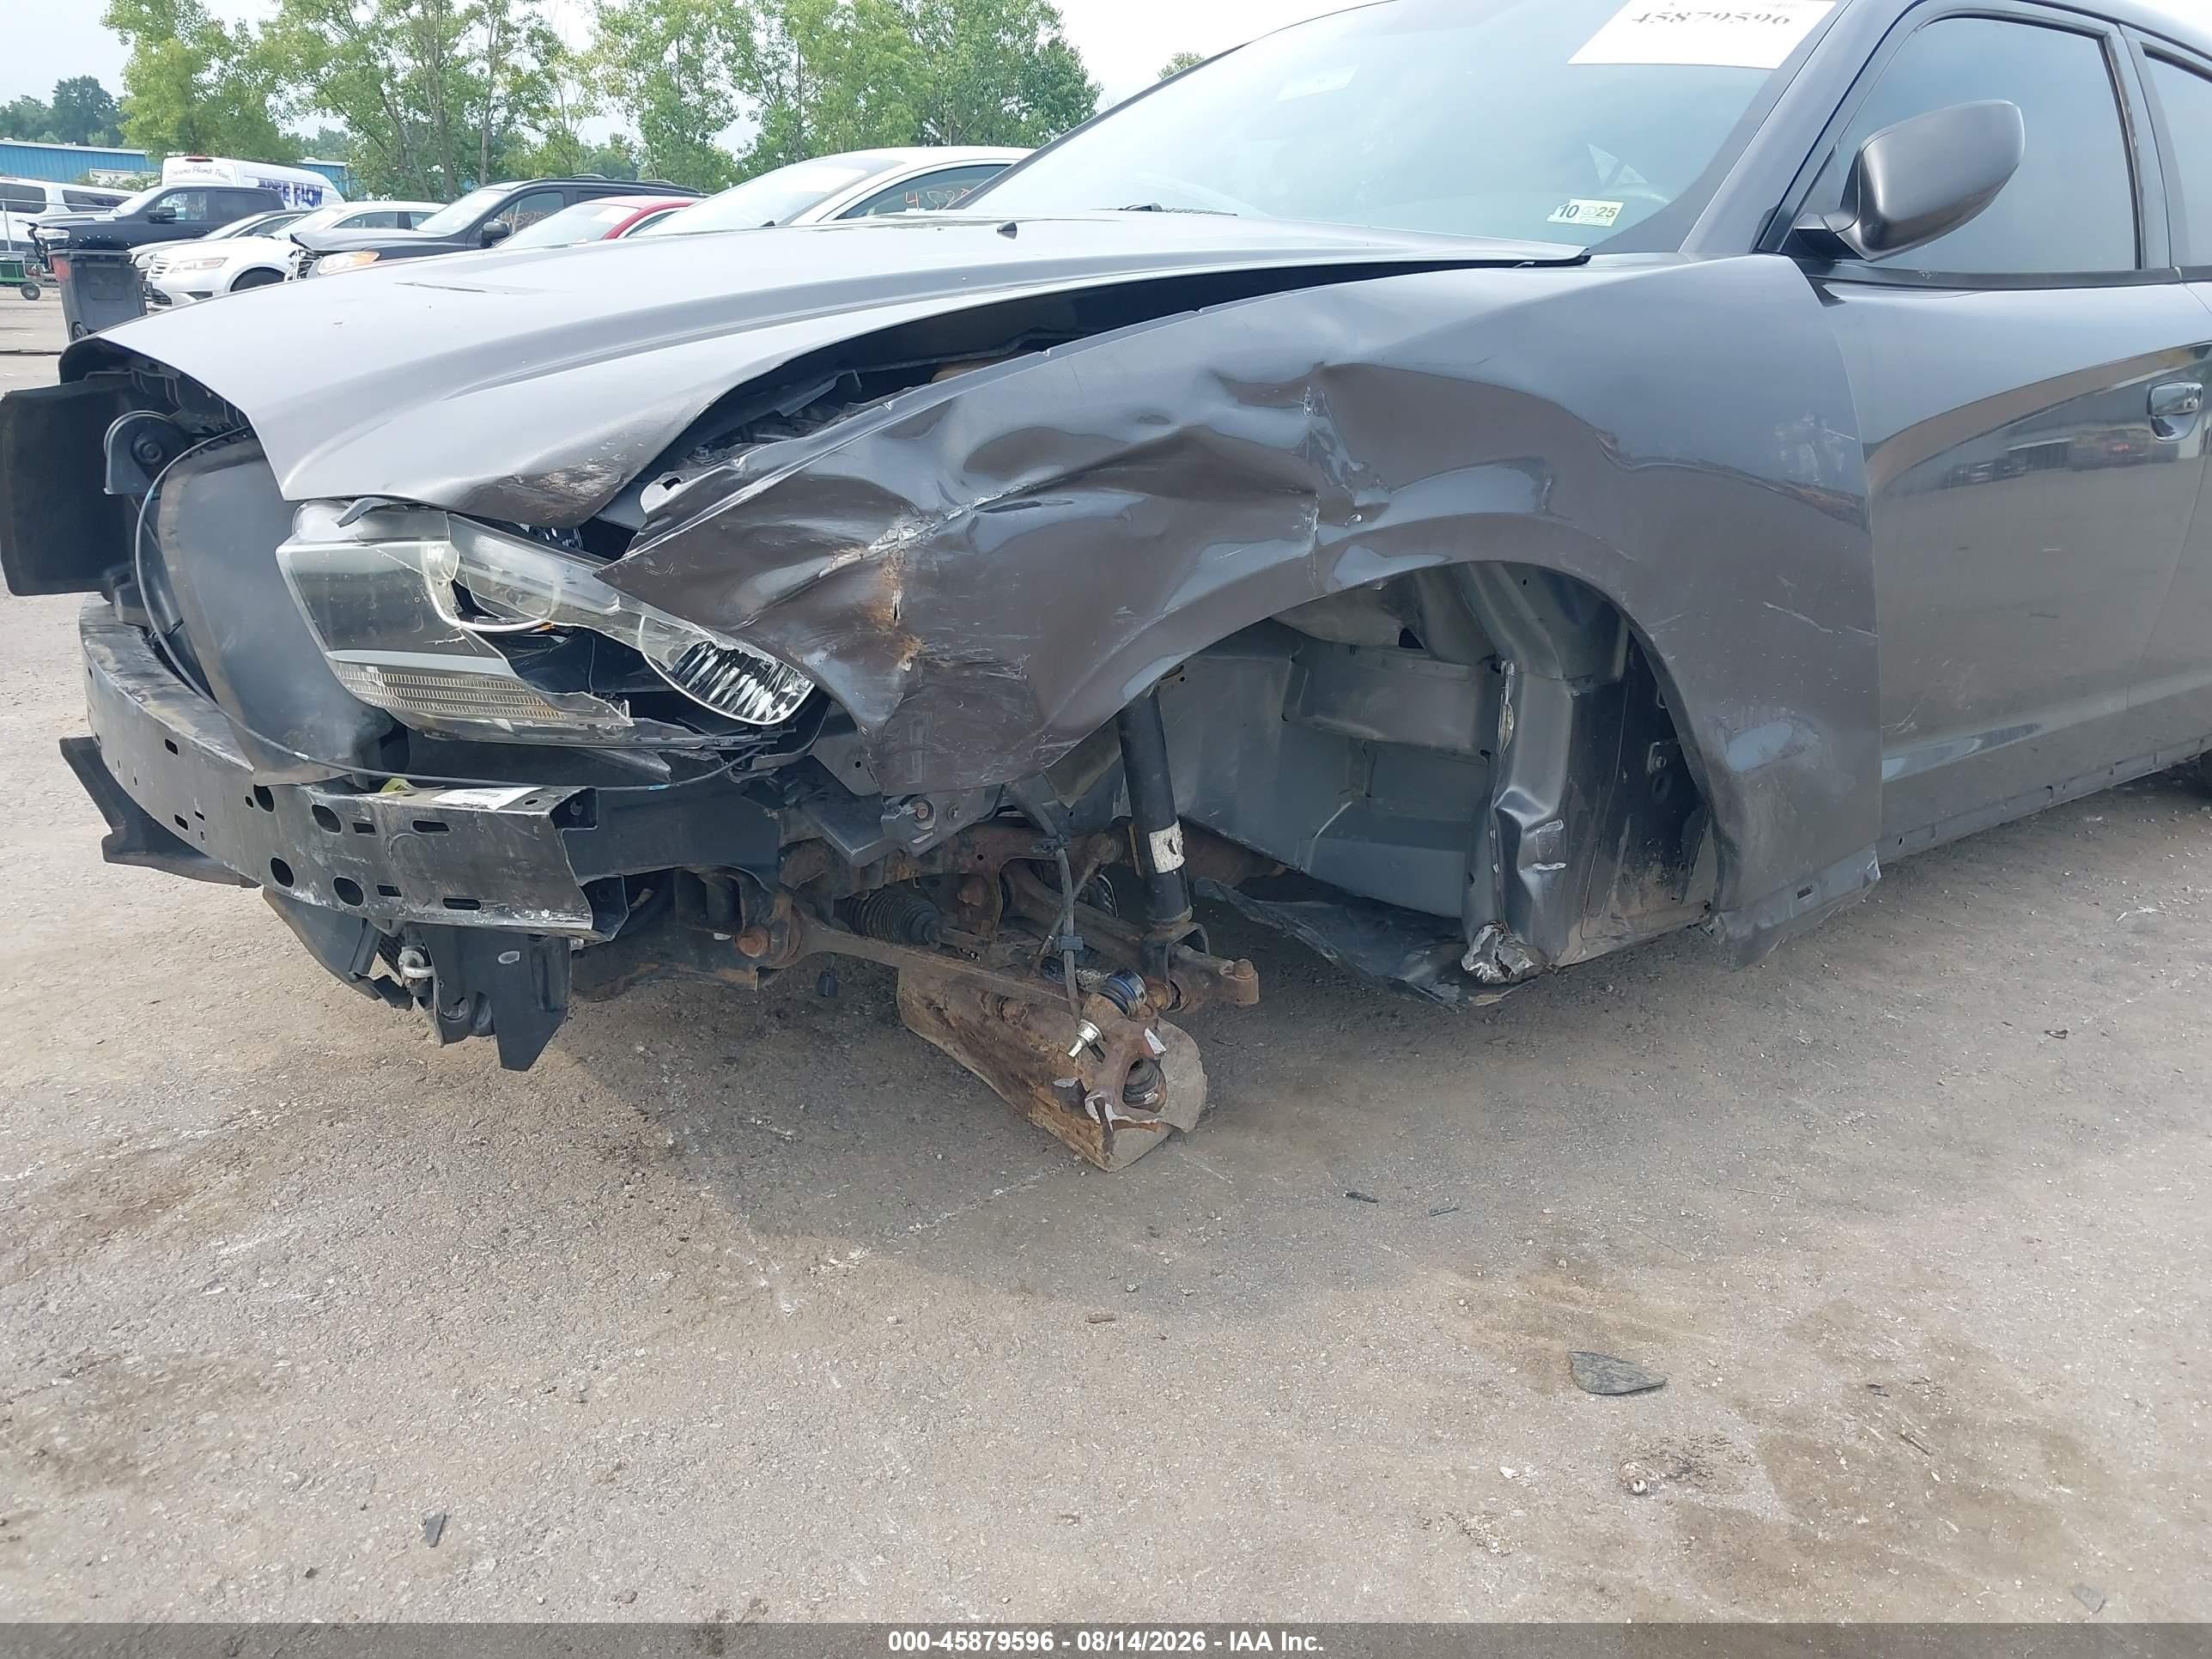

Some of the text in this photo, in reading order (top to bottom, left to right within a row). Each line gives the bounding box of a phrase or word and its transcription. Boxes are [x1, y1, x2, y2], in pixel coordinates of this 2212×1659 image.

[1632, 11, 1790, 25] 45879596
[293, 183, 323, 207] FLOW
[1559, 204, 1618, 218] 10 25
